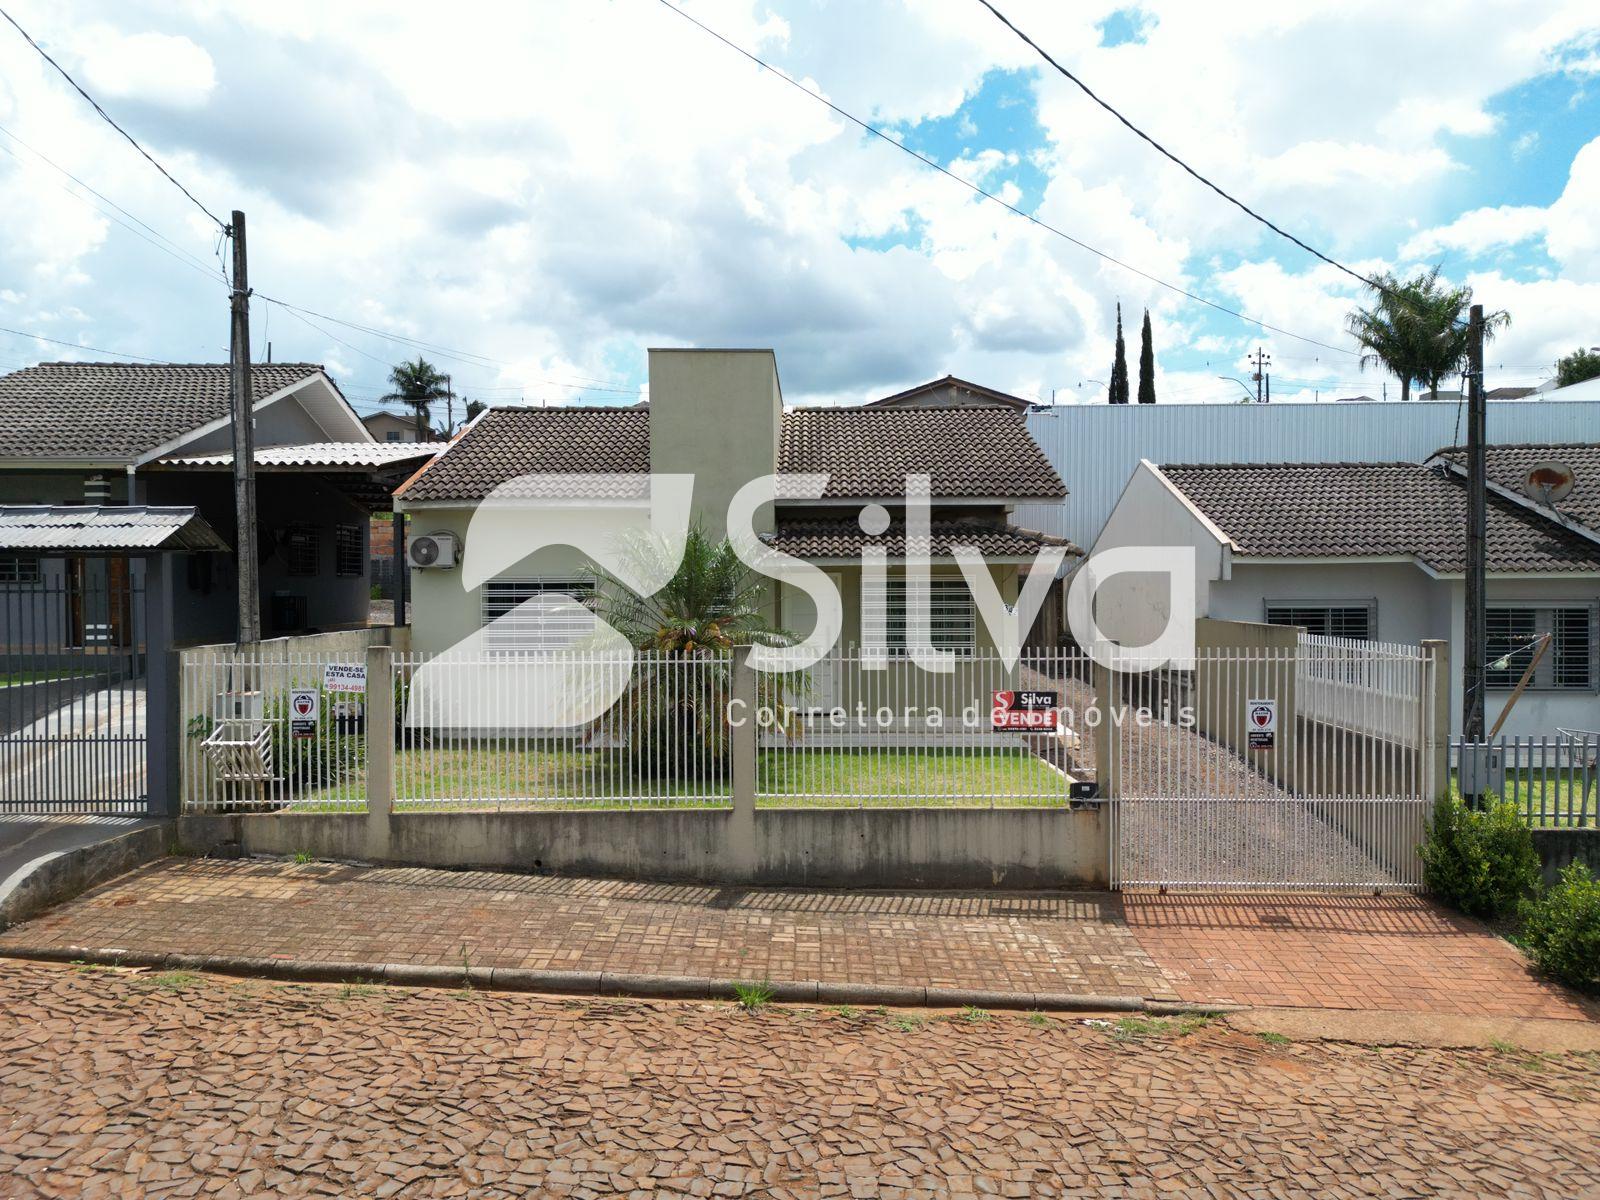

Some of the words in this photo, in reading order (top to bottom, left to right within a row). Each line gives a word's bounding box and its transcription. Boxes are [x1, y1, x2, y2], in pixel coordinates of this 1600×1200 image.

[329, 665, 364, 673] VENDE-SE
[1021, 693, 1052, 705] Silva
[1001, 712, 1053, 726] VENDE
